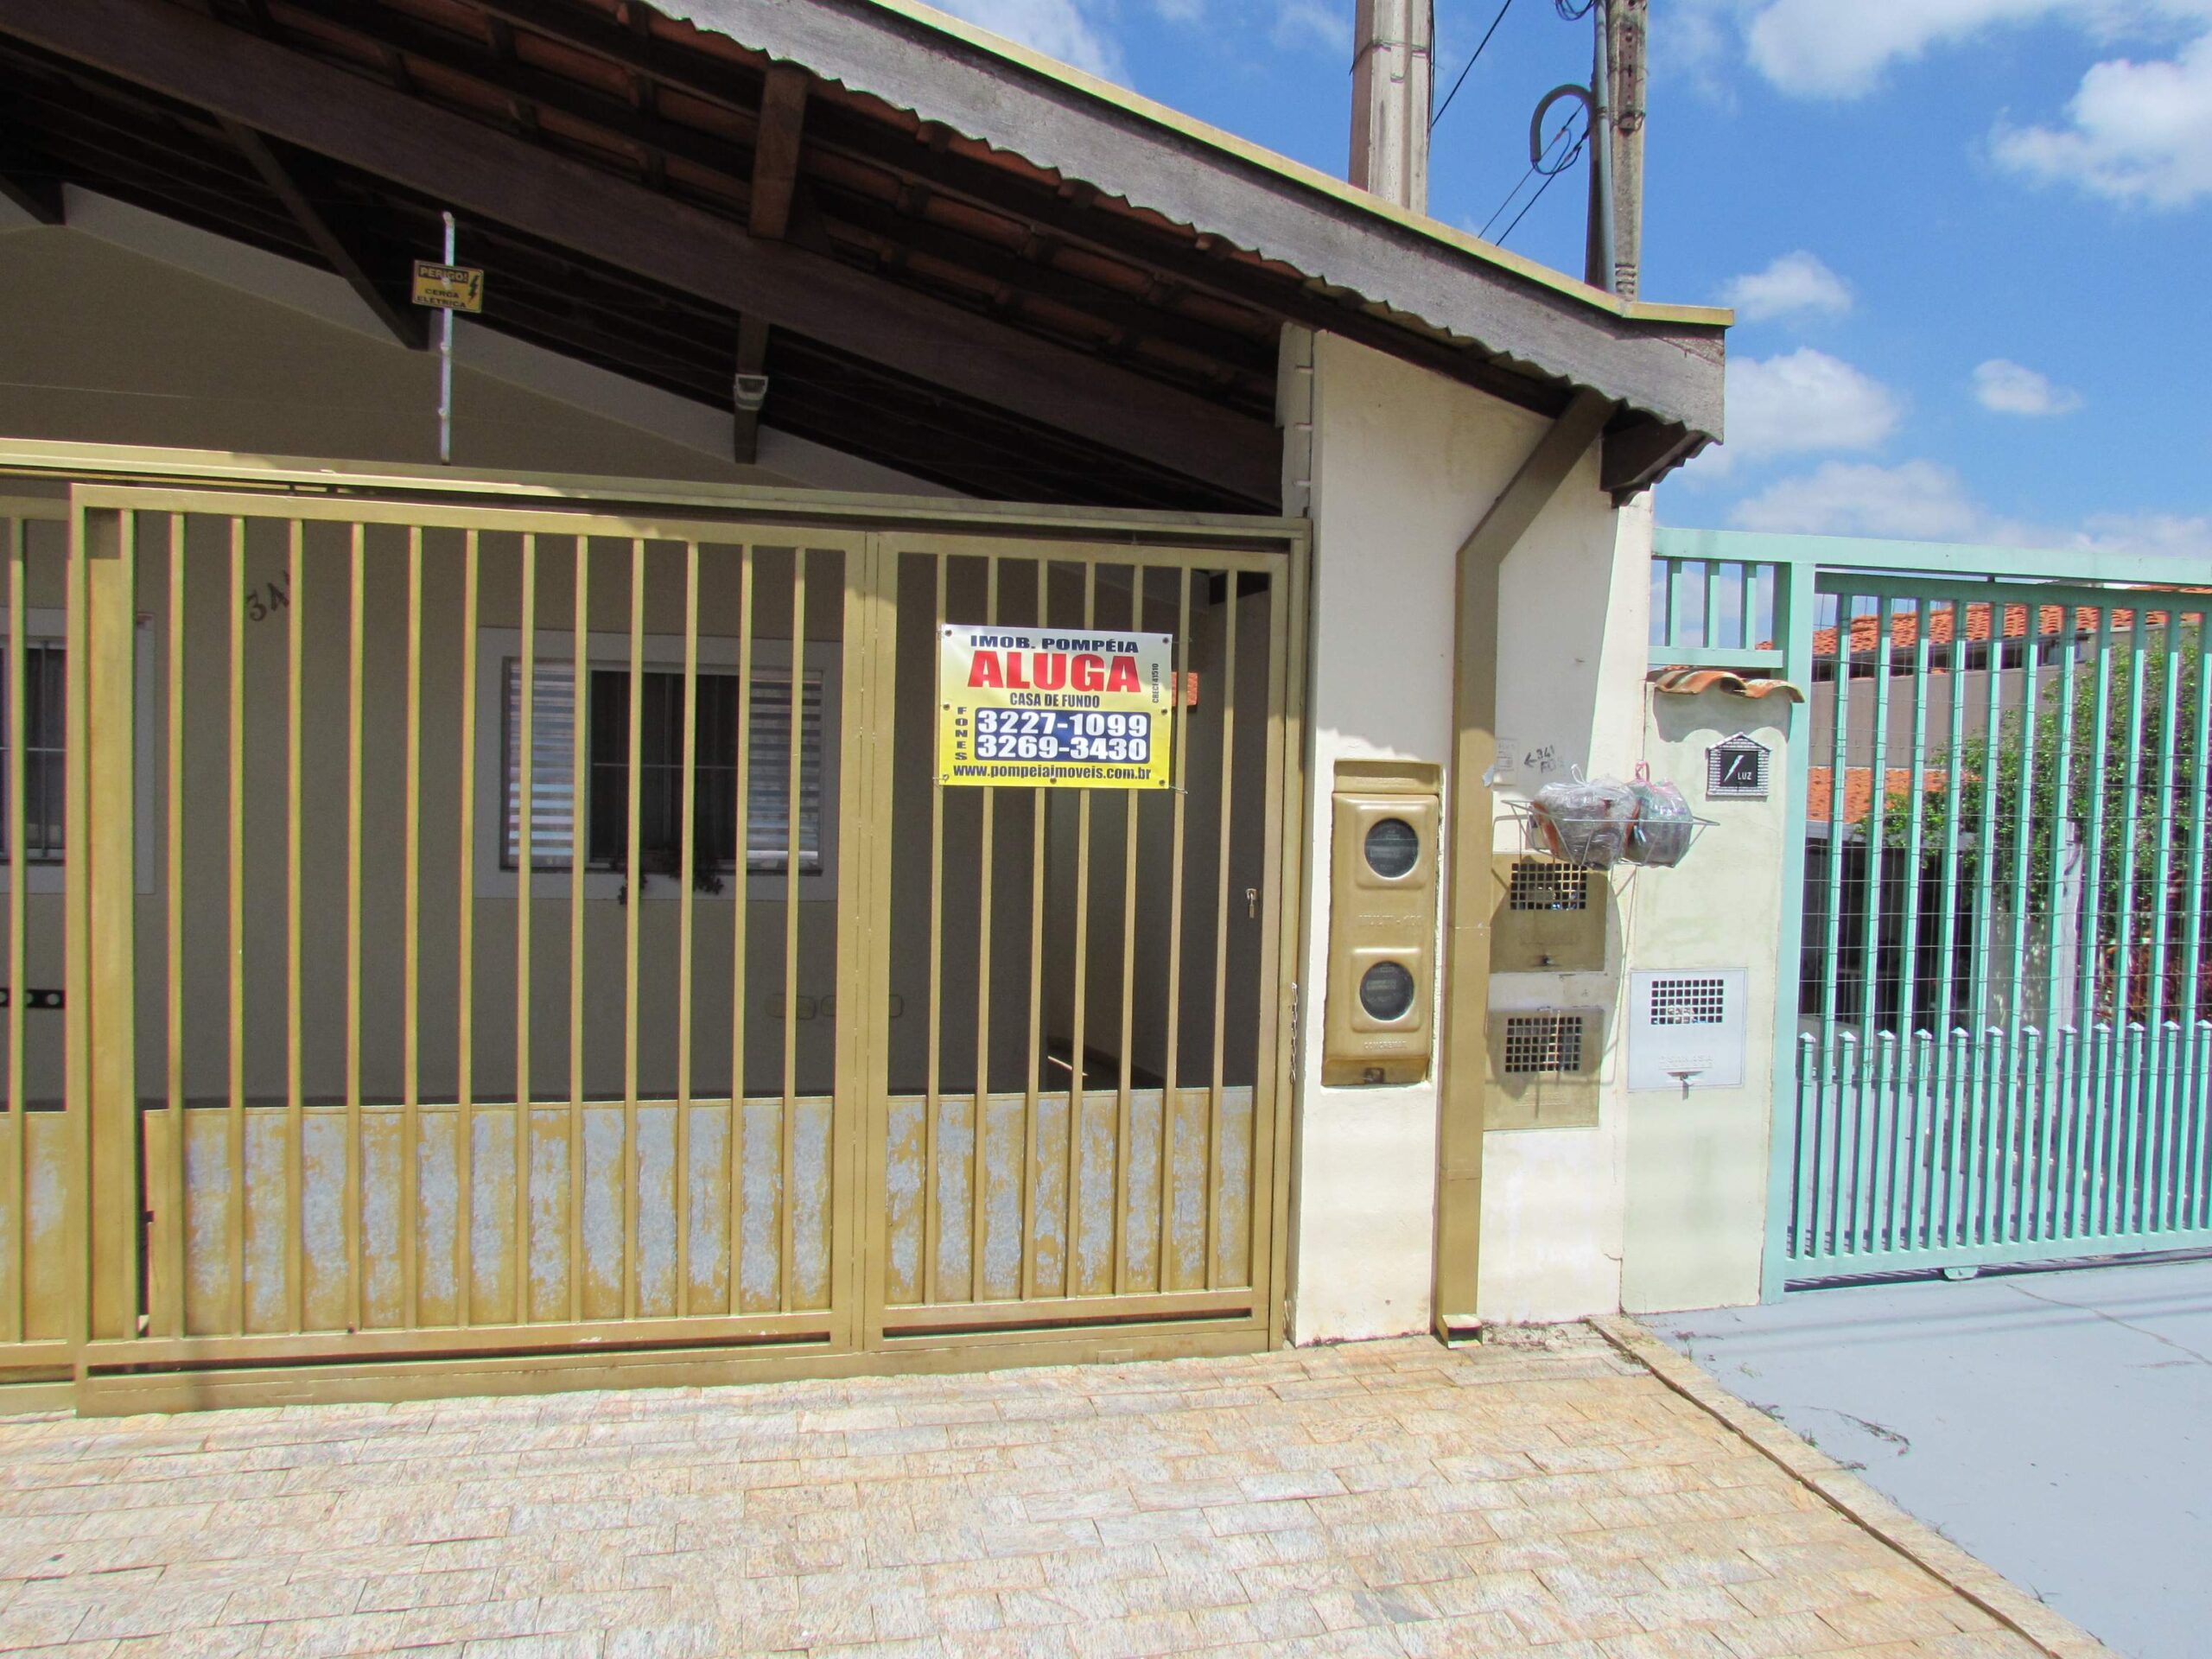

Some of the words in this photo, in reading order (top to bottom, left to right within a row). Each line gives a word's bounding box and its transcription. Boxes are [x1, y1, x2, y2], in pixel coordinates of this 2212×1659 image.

[419, 266, 467, 283] PERIGO!
[424, 288, 460, 299] CERCA
[970, 635, 1036, 649] IMOB.
[1042, 638, 1139, 653] POMPÉIA
[968, 650, 1141, 692] ALUGA
[1010, 692, 1042, 707] CASA
[1044, 693, 1059, 707] DE
[1062, 694, 1100, 709] FUNDO
[977, 709, 1147, 737] 3227-1099
[977, 734, 1147, 761] 3269-3430
[953, 764, 1151, 780] www.pompeiaimoveis.com.br
[1737, 772, 1752, 780] LUZ
